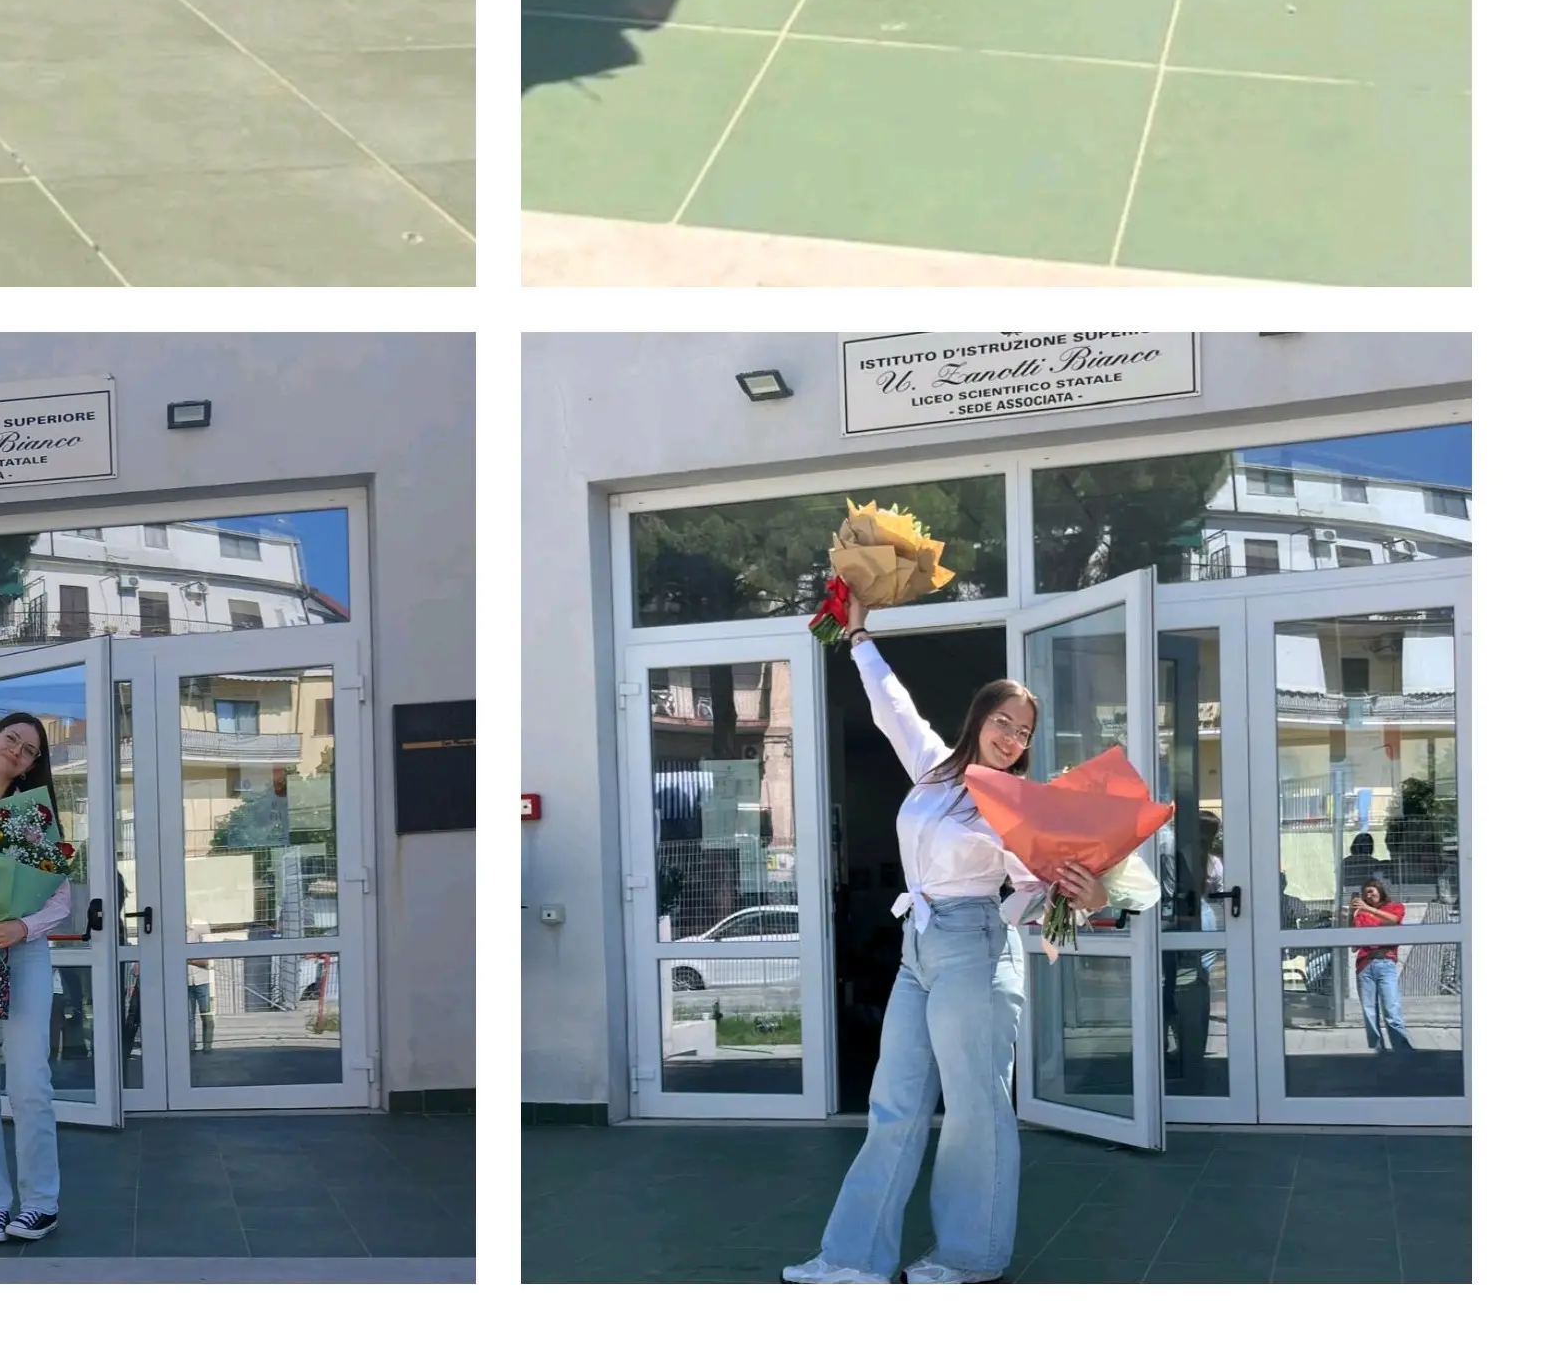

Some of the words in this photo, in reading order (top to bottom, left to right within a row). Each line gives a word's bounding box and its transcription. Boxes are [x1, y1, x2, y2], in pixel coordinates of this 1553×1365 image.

[861, 351, 937, 370] ISTITUTO
[943, 333, 1068, 361] D'ISTRUZIONE
[876, 371, 916, 395] U.
[932, 359, 1047, 388] Zanotti
[1049, 346, 1162, 374] Bianco
[912, 394, 953, 407] LICEO
[958, 381, 1053, 401] SCIENTIFICO
[1056, 373, 1122, 389] STATALE
[959, 402, 992, 415] SEDE
[997, 393, 1073, 410] ASSOCIATA
[4, 411, 95, 428] SUPERIORE
